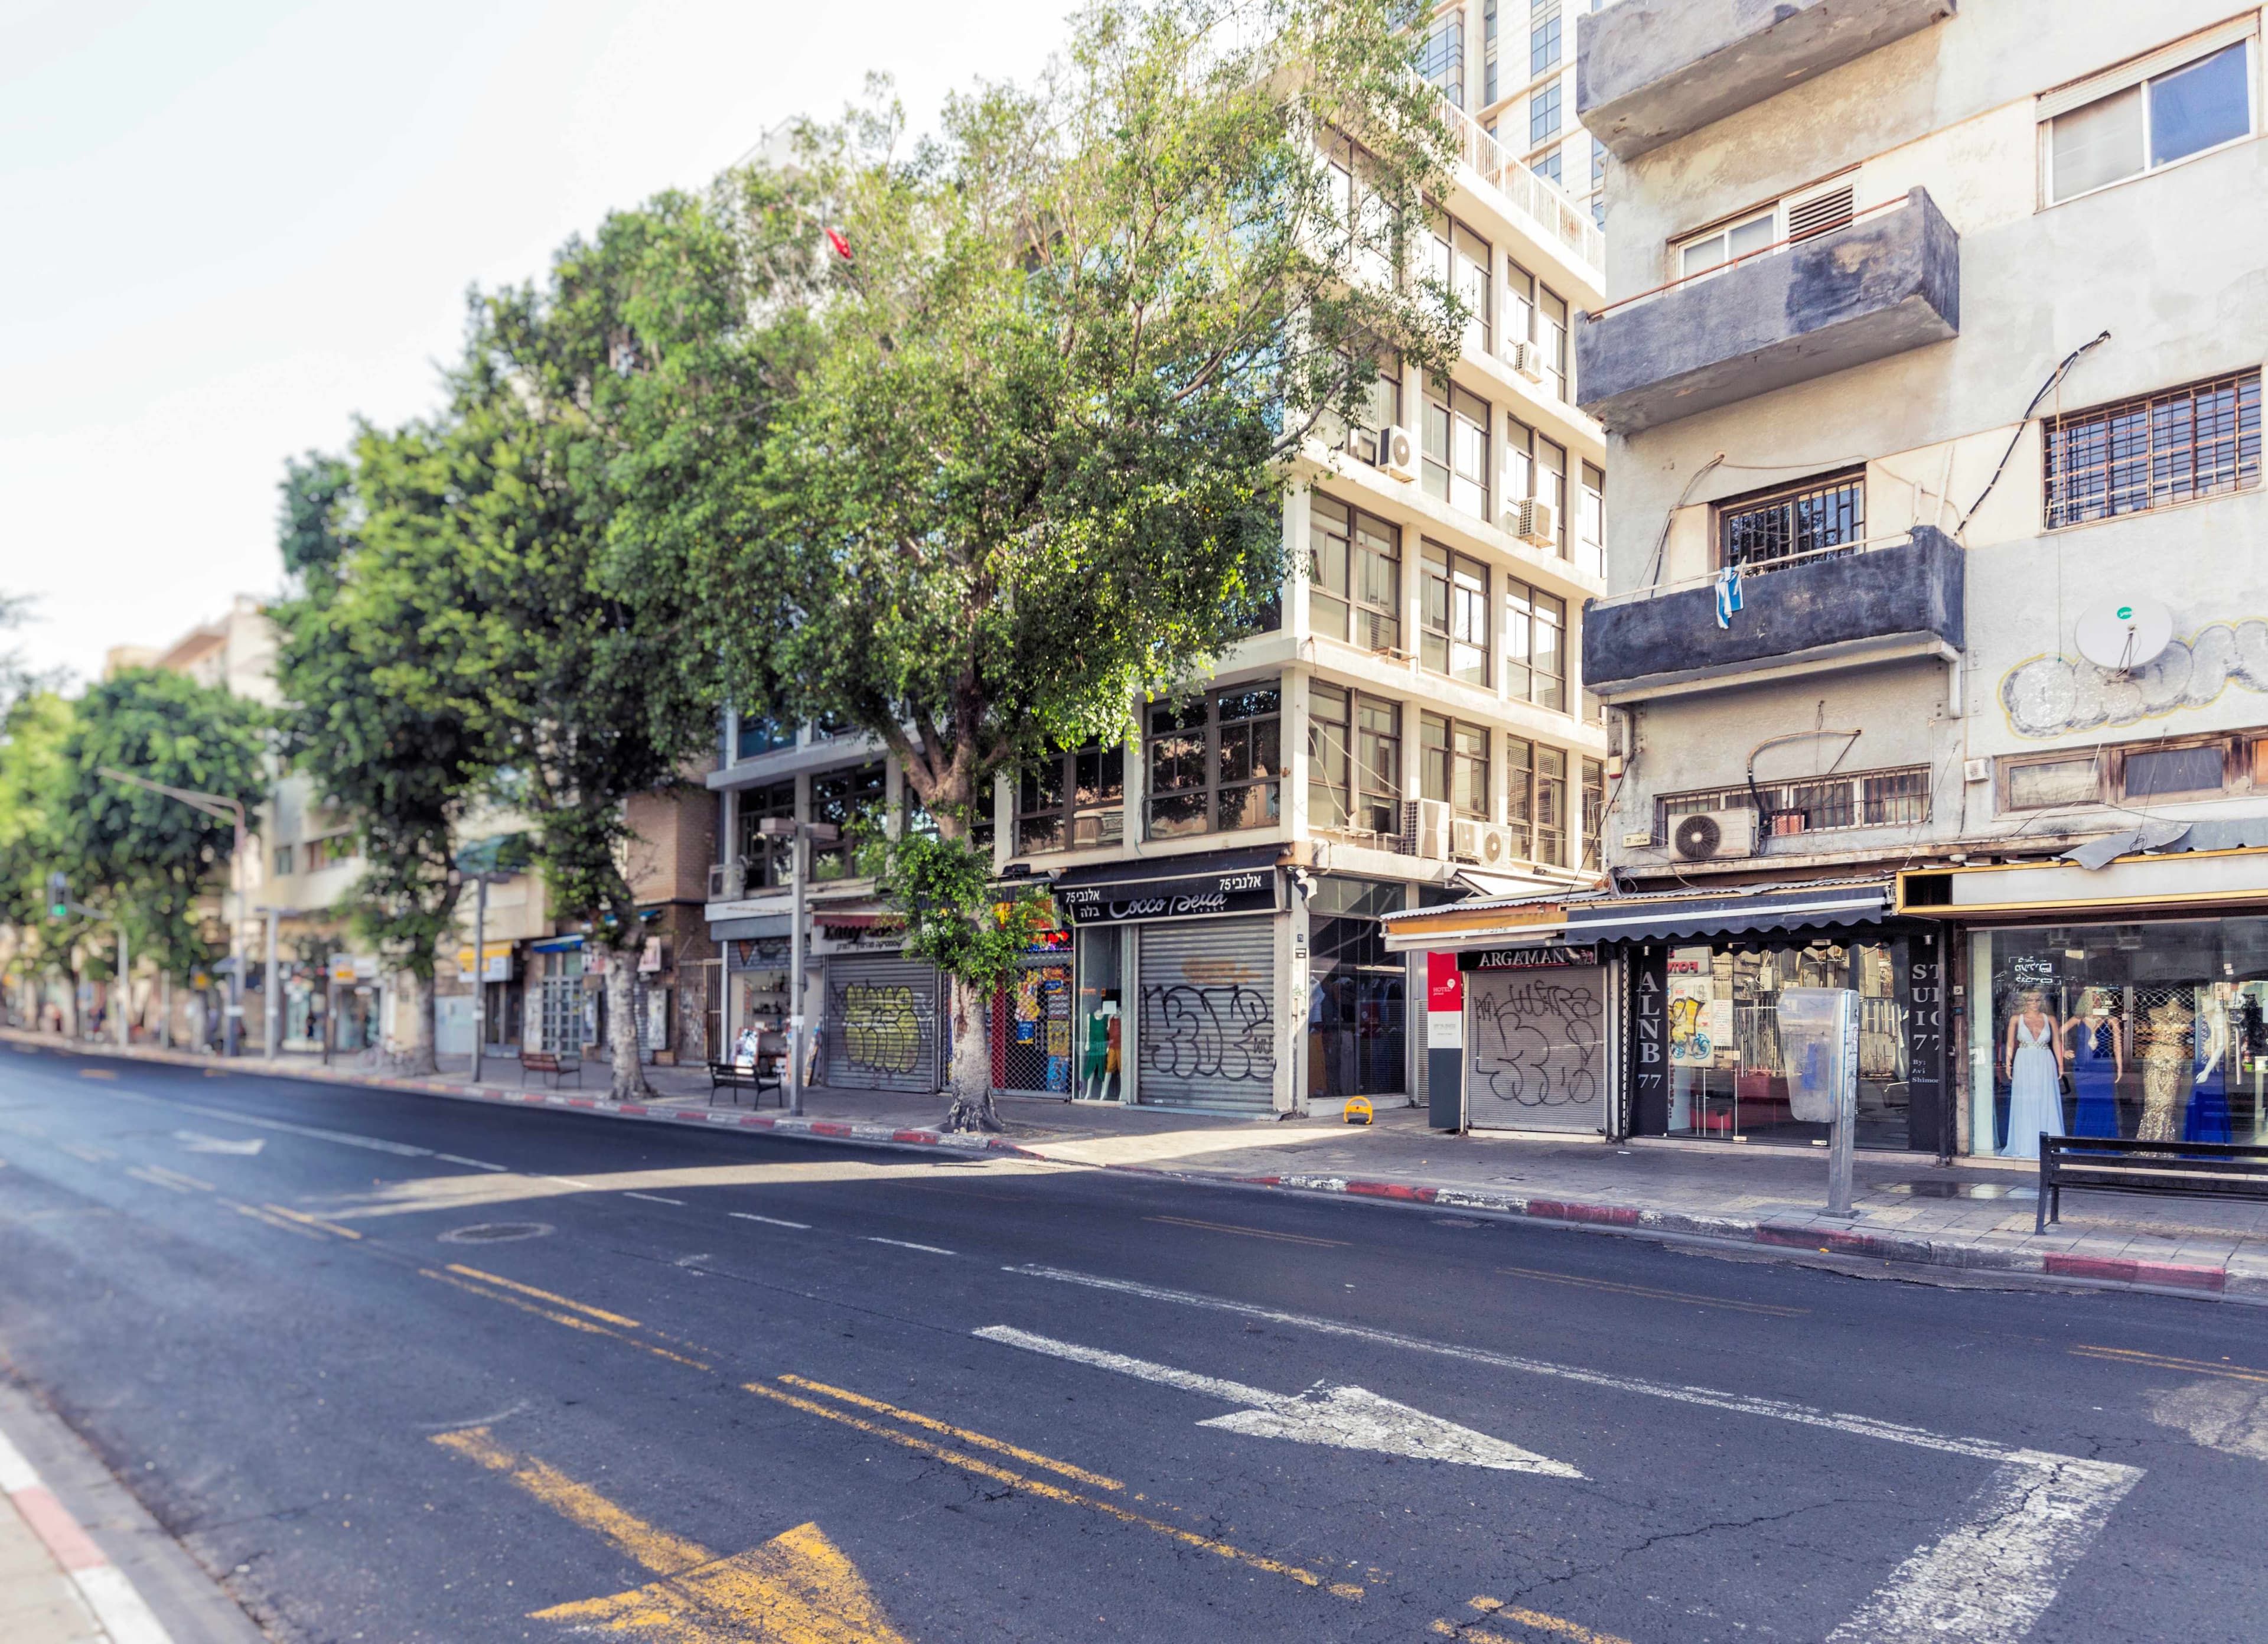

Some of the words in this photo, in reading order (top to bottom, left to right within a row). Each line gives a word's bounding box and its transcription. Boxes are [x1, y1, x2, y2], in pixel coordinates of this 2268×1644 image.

[1219, 878, 1231, 891] 75
[1232, 874, 1262, 890] אלנבי
[1065, 891, 1076, 903] 75
[1076, 890, 1100, 902] אלנבי
[1080, 905, 1100, 918] בלה
[1479, 946, 1566, 967] ARGAMAN
[1637, 1074, 1662, 1089] 77
